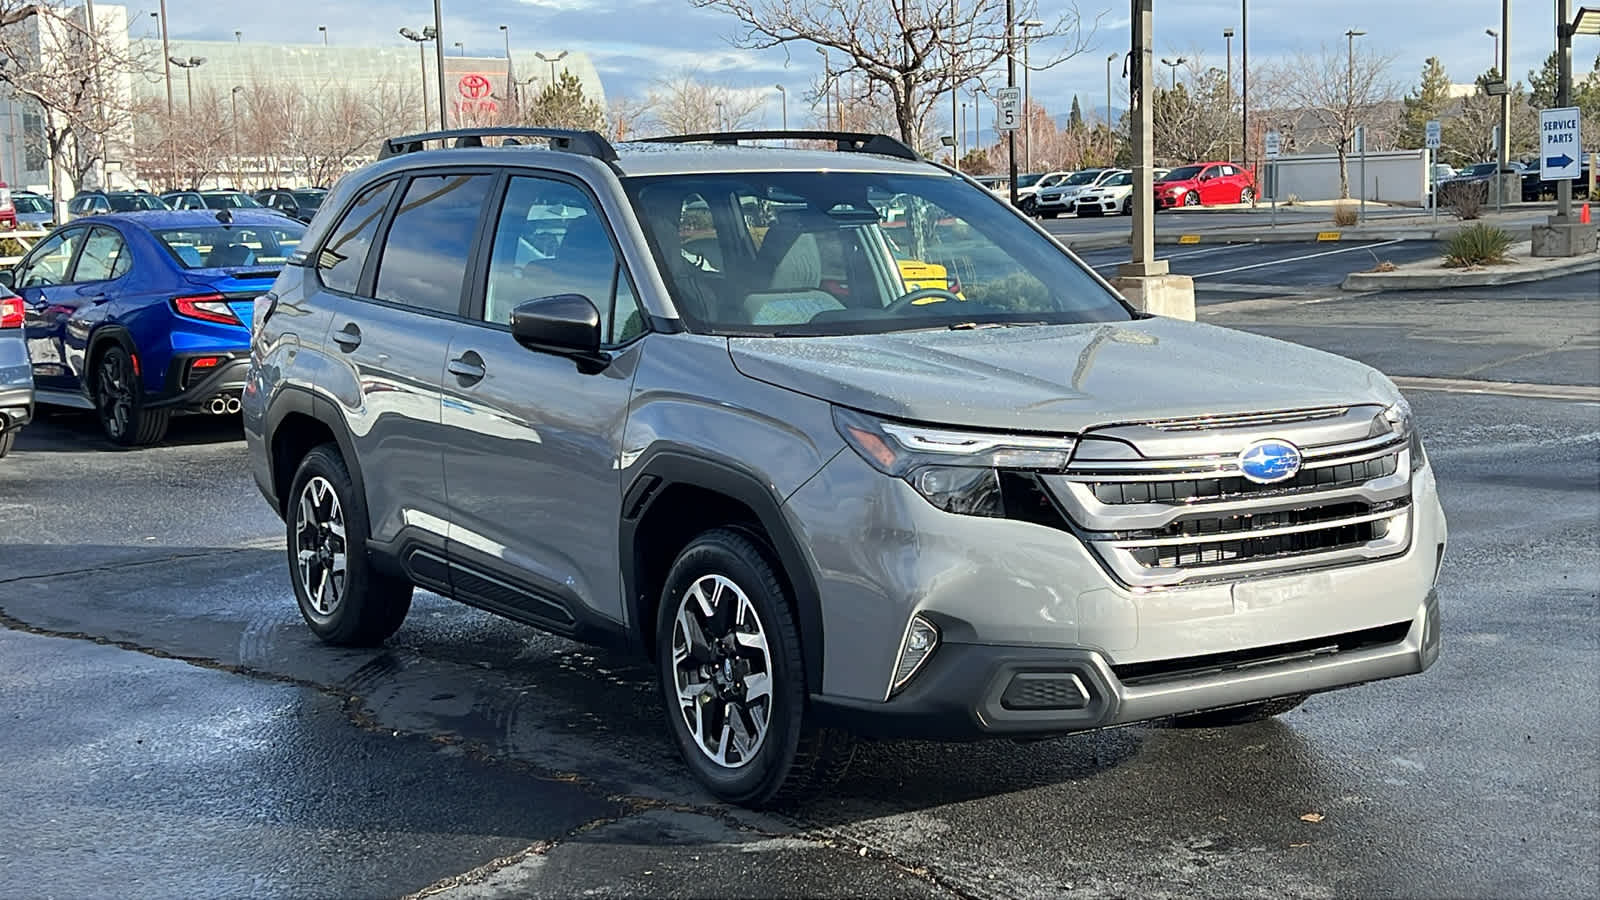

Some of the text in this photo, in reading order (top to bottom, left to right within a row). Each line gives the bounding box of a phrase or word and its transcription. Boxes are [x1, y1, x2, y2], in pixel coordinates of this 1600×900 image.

[453, 101, 497, 112] TOYTA
[1005, 110, 1014, 125] 5
[1543, 119, 1577, 131] SERVICE
[1547, 133, 1573, 144] PARTS
